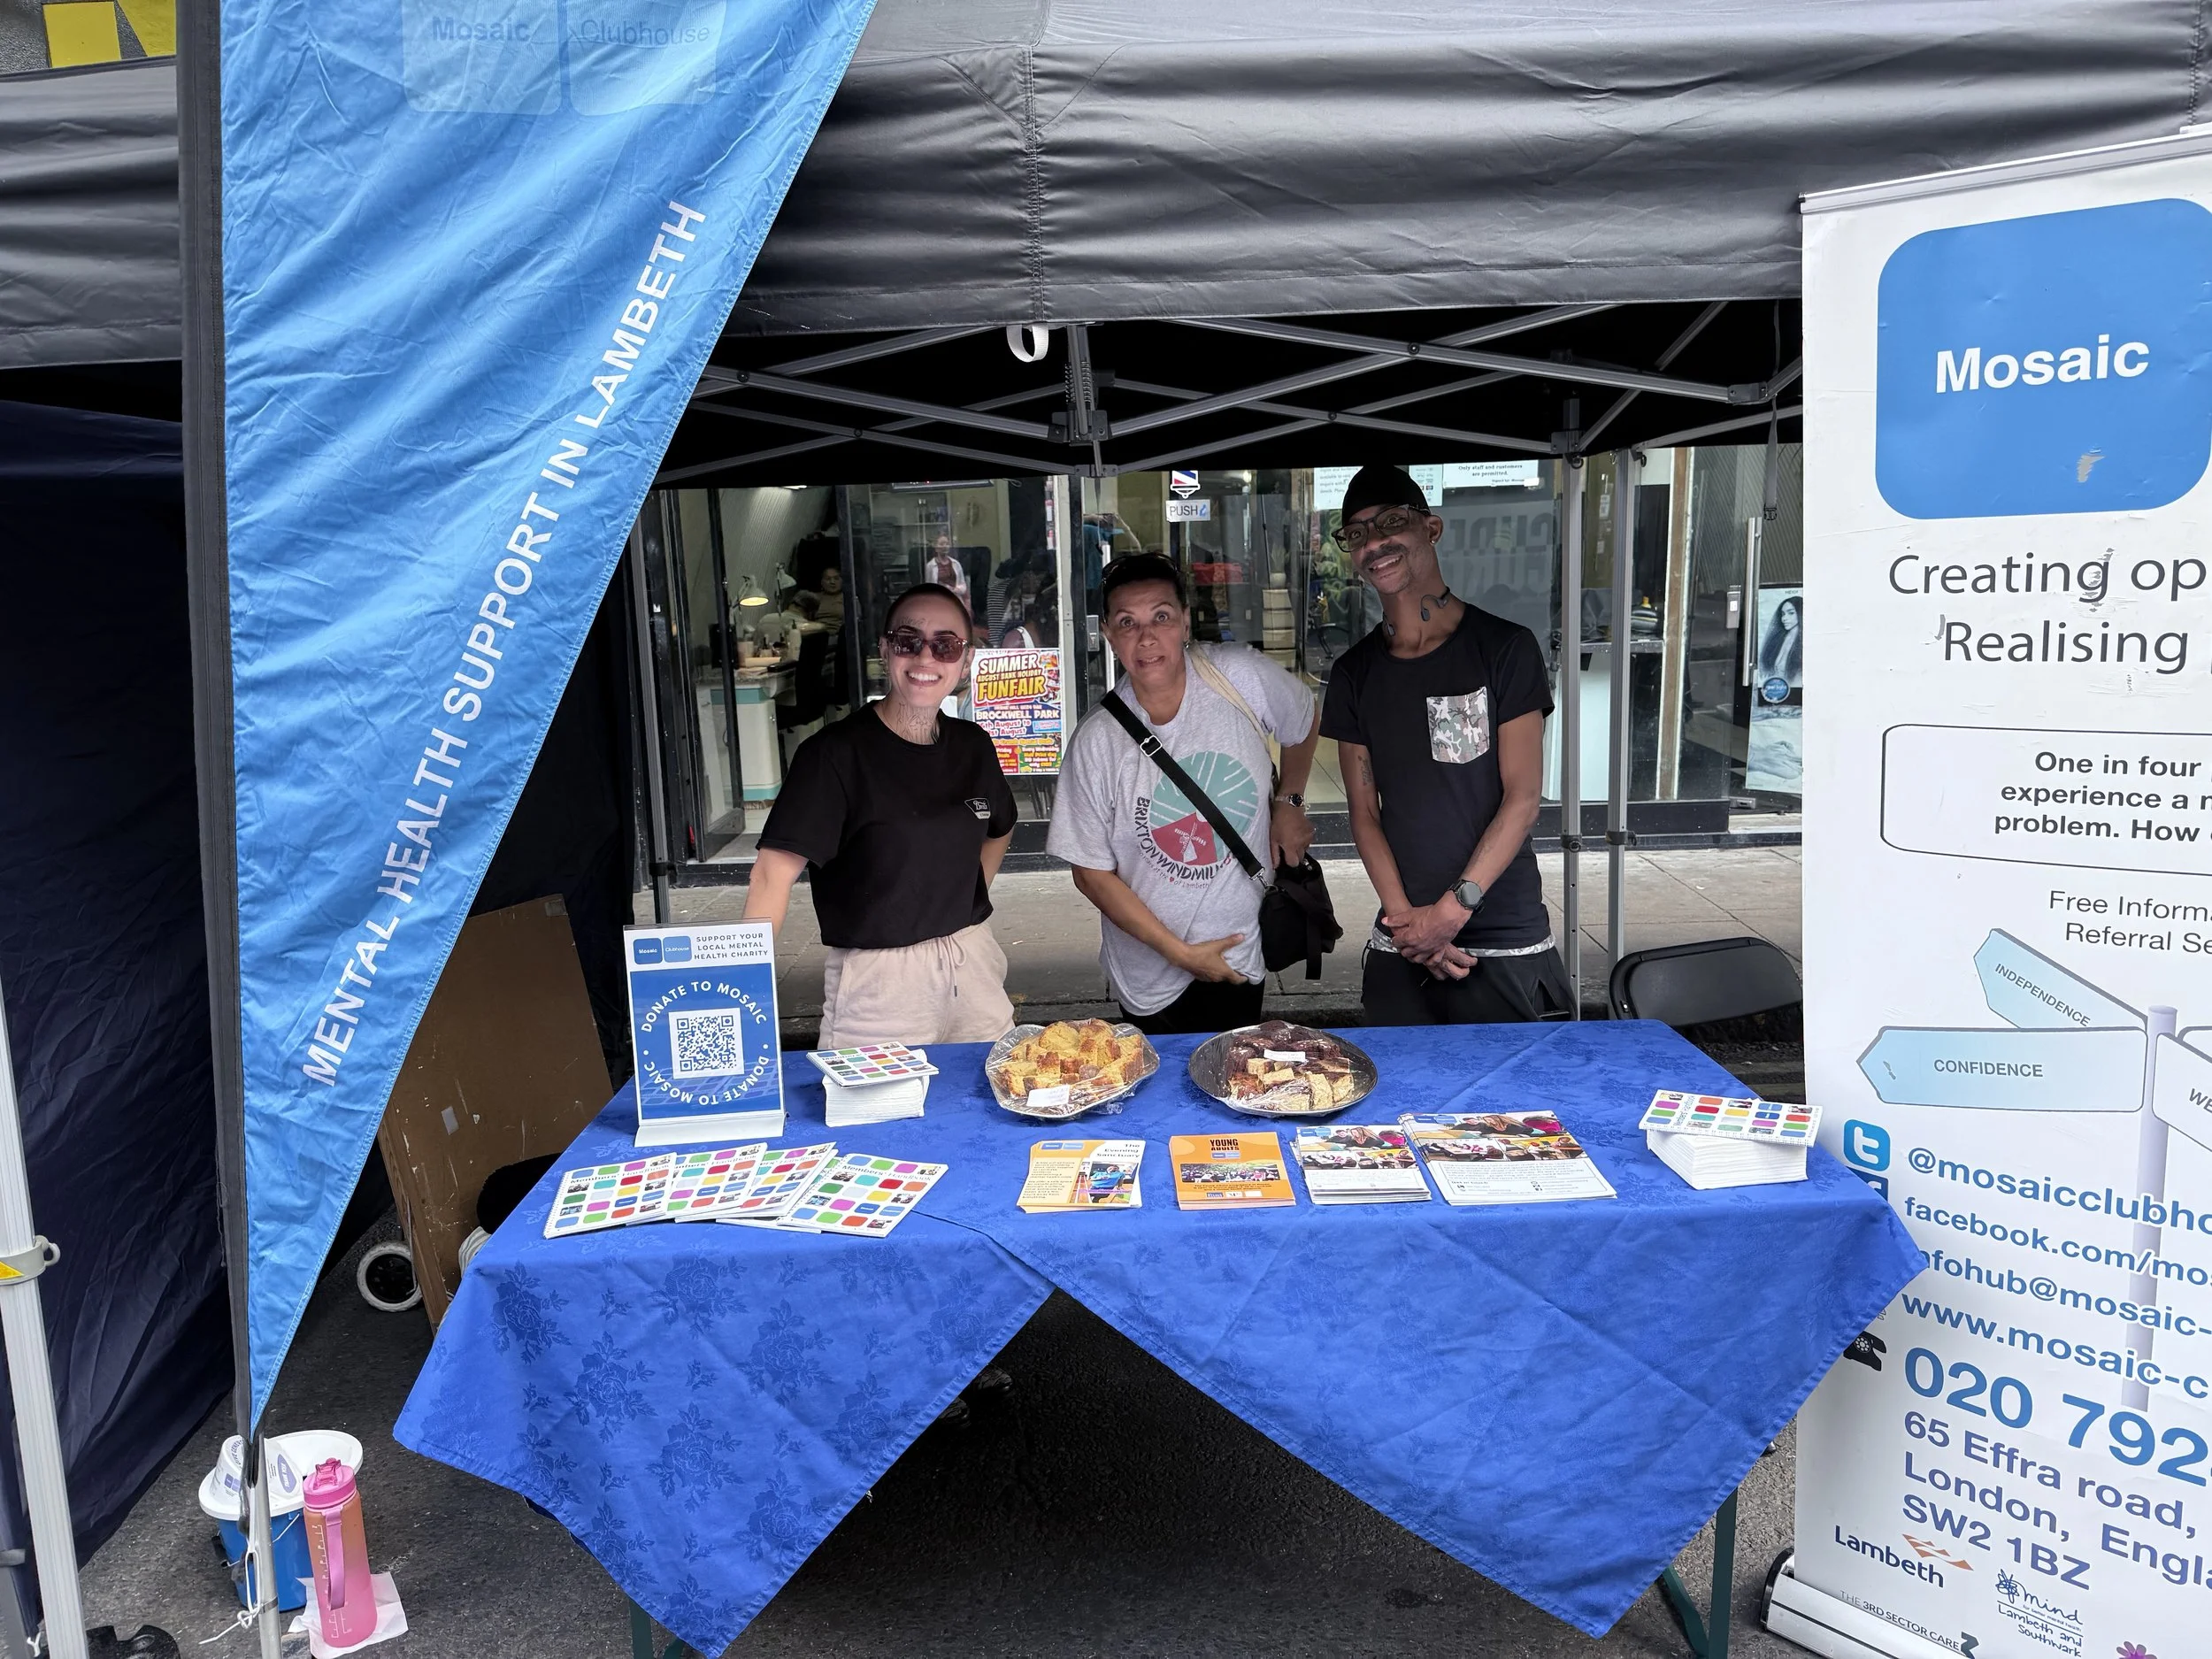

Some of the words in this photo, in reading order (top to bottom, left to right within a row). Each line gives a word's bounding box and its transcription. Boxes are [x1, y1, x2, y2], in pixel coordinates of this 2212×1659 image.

[432, 17, 532, 42] Mosaic
[580, 19, 710, 45] Clubhouse
[1935, 334, 2150, 394] Mosaic
[1170, 505, 1198, 516] PUSH
[1889, 552, 2110, 602] Creating
[2131, 557, 2207, 602] op
[302, 915, 400, 1087] MENTAL
[377, 727, 468, 903] HEALTH
[443, 492, 559, 722] SUPPORT
[540, 440, 588, 489] IN
[575, 200, 707, 430] LAMBETH
[1945, 620, 2188, 674] Realising
[979, 654, 1038, 674] SUMMER
[1018, 670, 1041, 679] HOLIDAY
[978, 676, 1045, 701] FUNFAIR
[976, 710, 1032, 720] BROCKWELL
[1034, 710, 1059, 718] PARK
[995, 719, 1020, 729] August
[2035, 751, 2093, 772] One
[2103, 755, 2128, 774] in
[2139, 756, 2201, 777] four
[2001, 785, 2162, 809] experience
[2172, 793, 2188, 810] a
[1134, 796, 1160, 858] BRIXTON
[1994, 814, 2119, 838] problem.
[2131, 819, 2200, 841] How
[2049, 890, 2108, 914] Free
[2118, 896, 2212, 922] Inform
[694, 951, 727, 960] HEALTH
[731, 949, 768, 958] CHARITY
[696, 933, 736, 942] SUPPORT
[2066, 923, 2171, 951] Referral
[641, 985, 687, 1033] DONATE
[691, 980, 711, 992] TO
[718, 982, 767, 1025] MOSAIC
[1994, 963, 2091, 1026] INDEPENDENCE
[643, 1062, 694, 1103] MOSAIC
[724, 1056, 770, 1102] DONATE
[1934, 1059, 2044, 1077] CONFIDENCE
[698, 1094, 718, 1105] TO
[1904, 1197, 2212, 1286] facebook.com/mo
[1902, 1294, 2208, 1398] www.mosaic-c
[1905, 1348, 2032, 1428] 020
[2062, 1394, 2212, 1486] 792
[1905, 1411, 1949, 1448] 65
[1964, 1430, 2061, 1490] Effra
[2078, 1476, 2196, 1539] road,
[1905, 1452, 2070, 1543] London,
[1835, 1525, 1944, 1588] Lambeth
[1903, 1494, 1992, 1551] SW2
[2007, 1537, 2091, 1590] 1BZ
[1840, 1589, 1861, 1605] THE
[1863, 1601, 1884, 1617] 3RD
[1886, 1611, 1928, 1637] SECTOR
[1930, 1631, 1960, 1652] CARE
[1999, 1604, 2054, 1634] Lambeth
[2060, 1632, 2082, 1647] and
[2024, 1590, 2083, 1625] mind
[2018, 1624, 2082, 1657] Southwark
